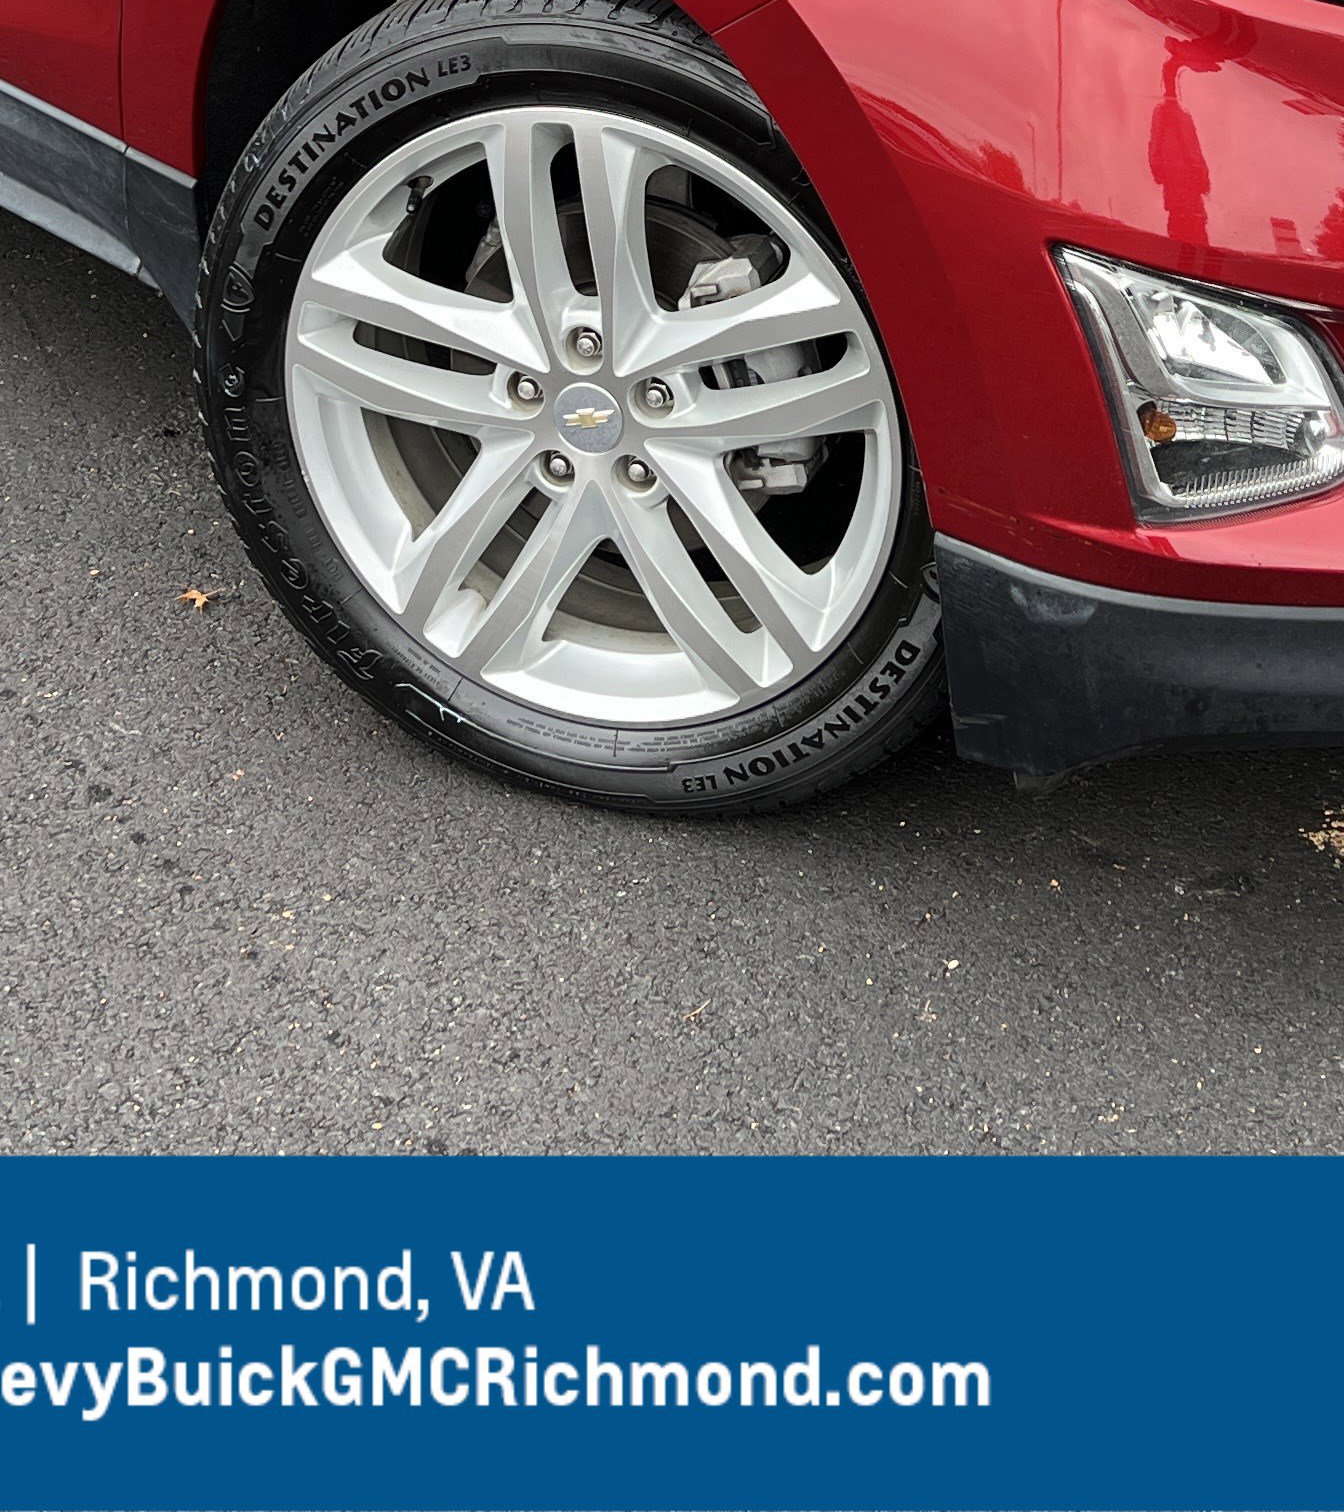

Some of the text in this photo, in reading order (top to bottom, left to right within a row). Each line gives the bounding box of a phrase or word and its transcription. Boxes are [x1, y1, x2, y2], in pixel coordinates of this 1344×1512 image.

[254, 67, 431, 231] DESTINATION
[438, 54, 471, 78] LE3
[682, 774, 718, 793] LE3
[723, 639, 921, 785] DESTINATION
